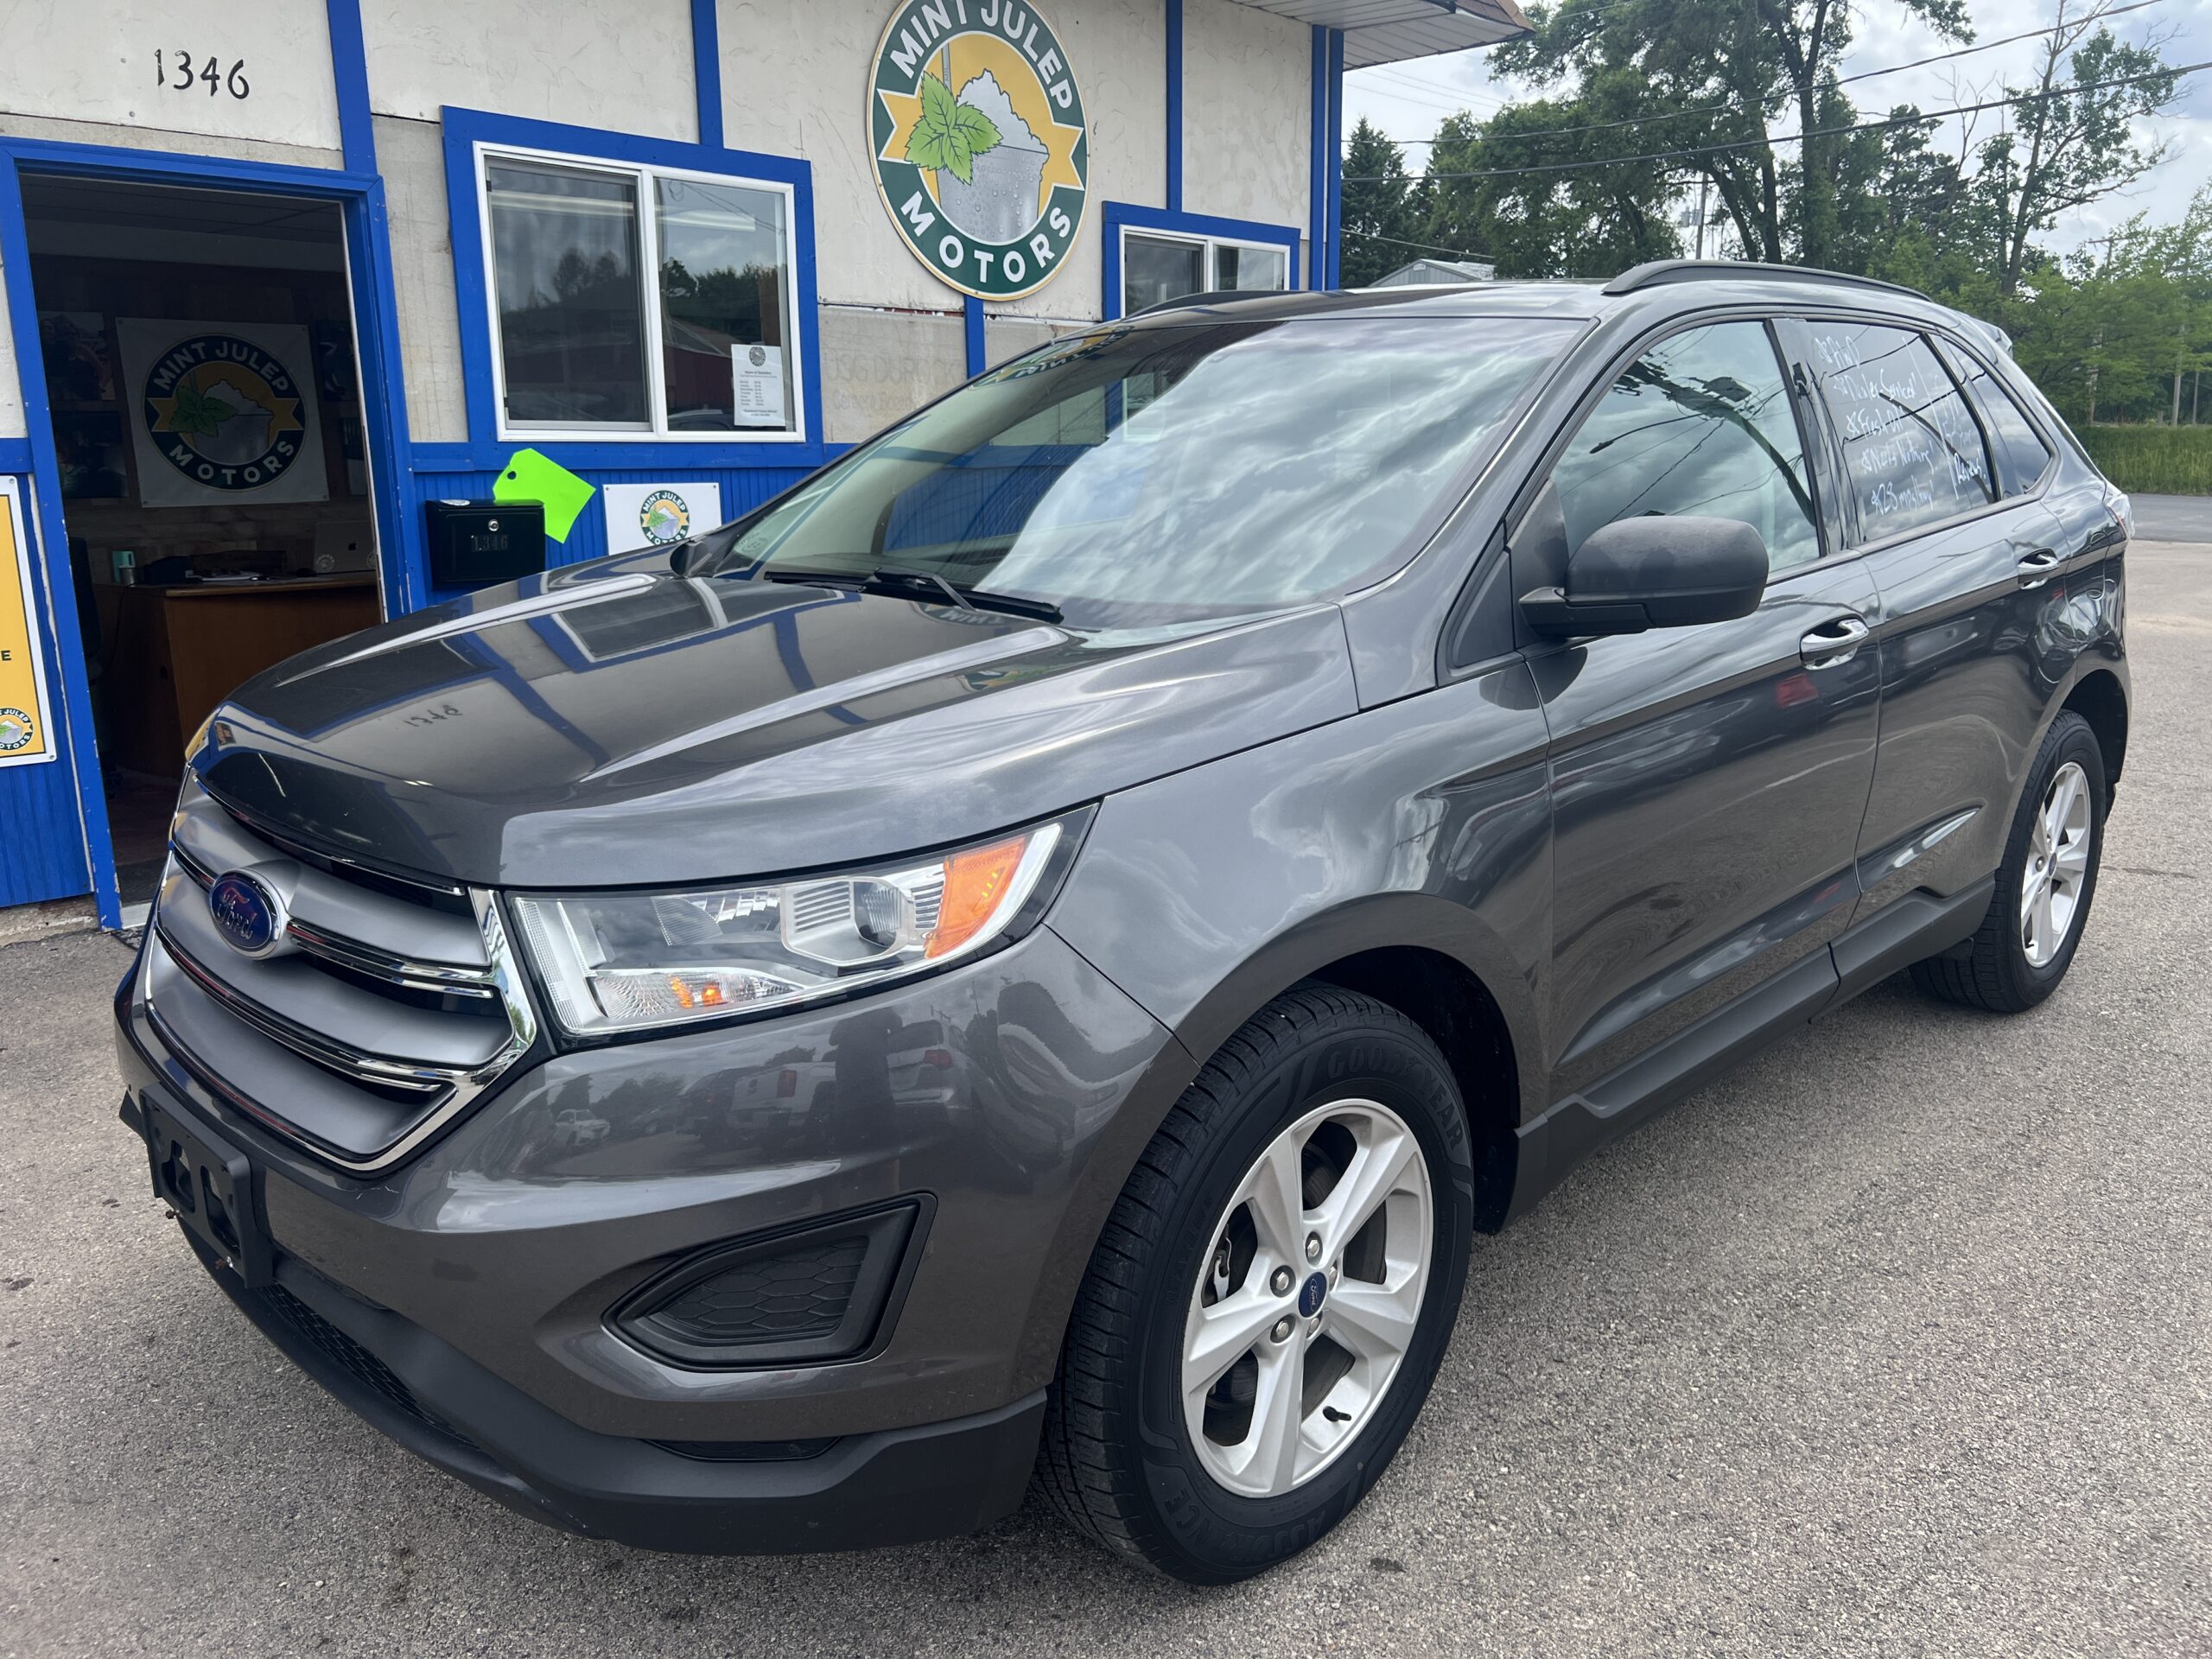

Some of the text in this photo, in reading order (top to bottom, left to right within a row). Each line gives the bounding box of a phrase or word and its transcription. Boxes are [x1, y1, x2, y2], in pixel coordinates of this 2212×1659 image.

[155, 48, 250, 99] 1346
[981, 0, 1073, 109] JULEP
[900, 191, 1071, 283] MOTORS
[154, 341, 289, 391] MINT JULEP
[169, 441, 295, 486] MOTORS
[643, 492, 686, 512] MINT JULEP
[471, 534, 509, 552] 1346
[4, 709, 29, 722] JULEP
[217, 887, 258, 940] Ford
